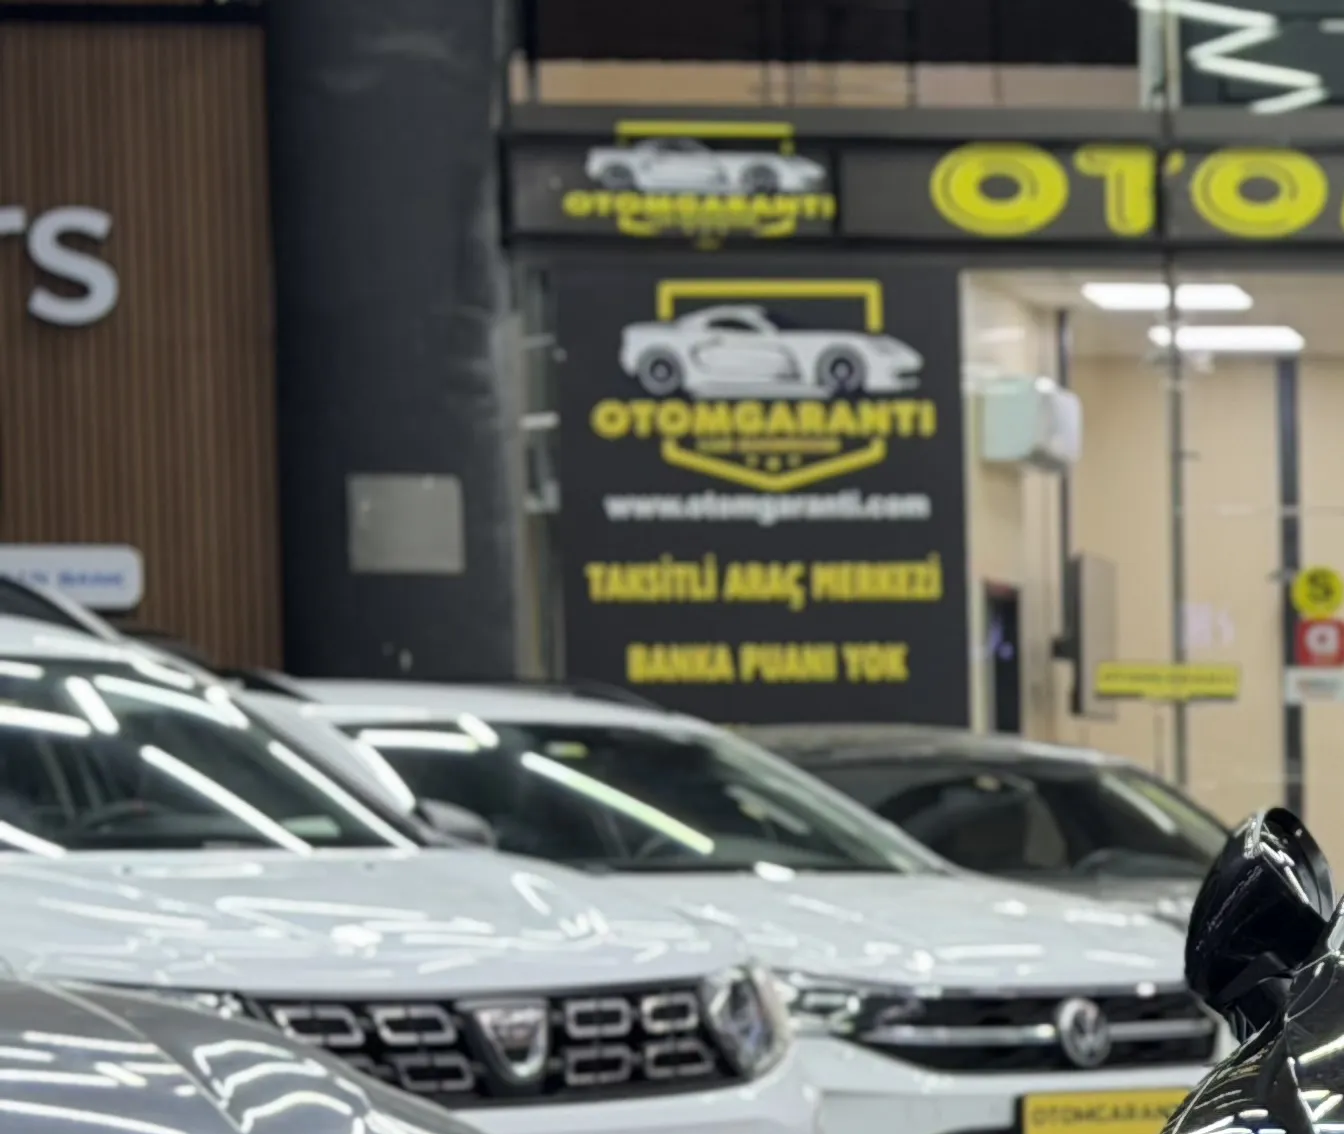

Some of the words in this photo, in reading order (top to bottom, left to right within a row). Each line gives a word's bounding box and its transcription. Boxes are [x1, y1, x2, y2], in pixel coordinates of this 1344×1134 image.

[591, 400, 937, 438] OTOMGARANTI
[724, 563, 806, 611] ARAÇ
[627, 644, 735, 684] BANKA
[842, 643, 910, 682] YOK
